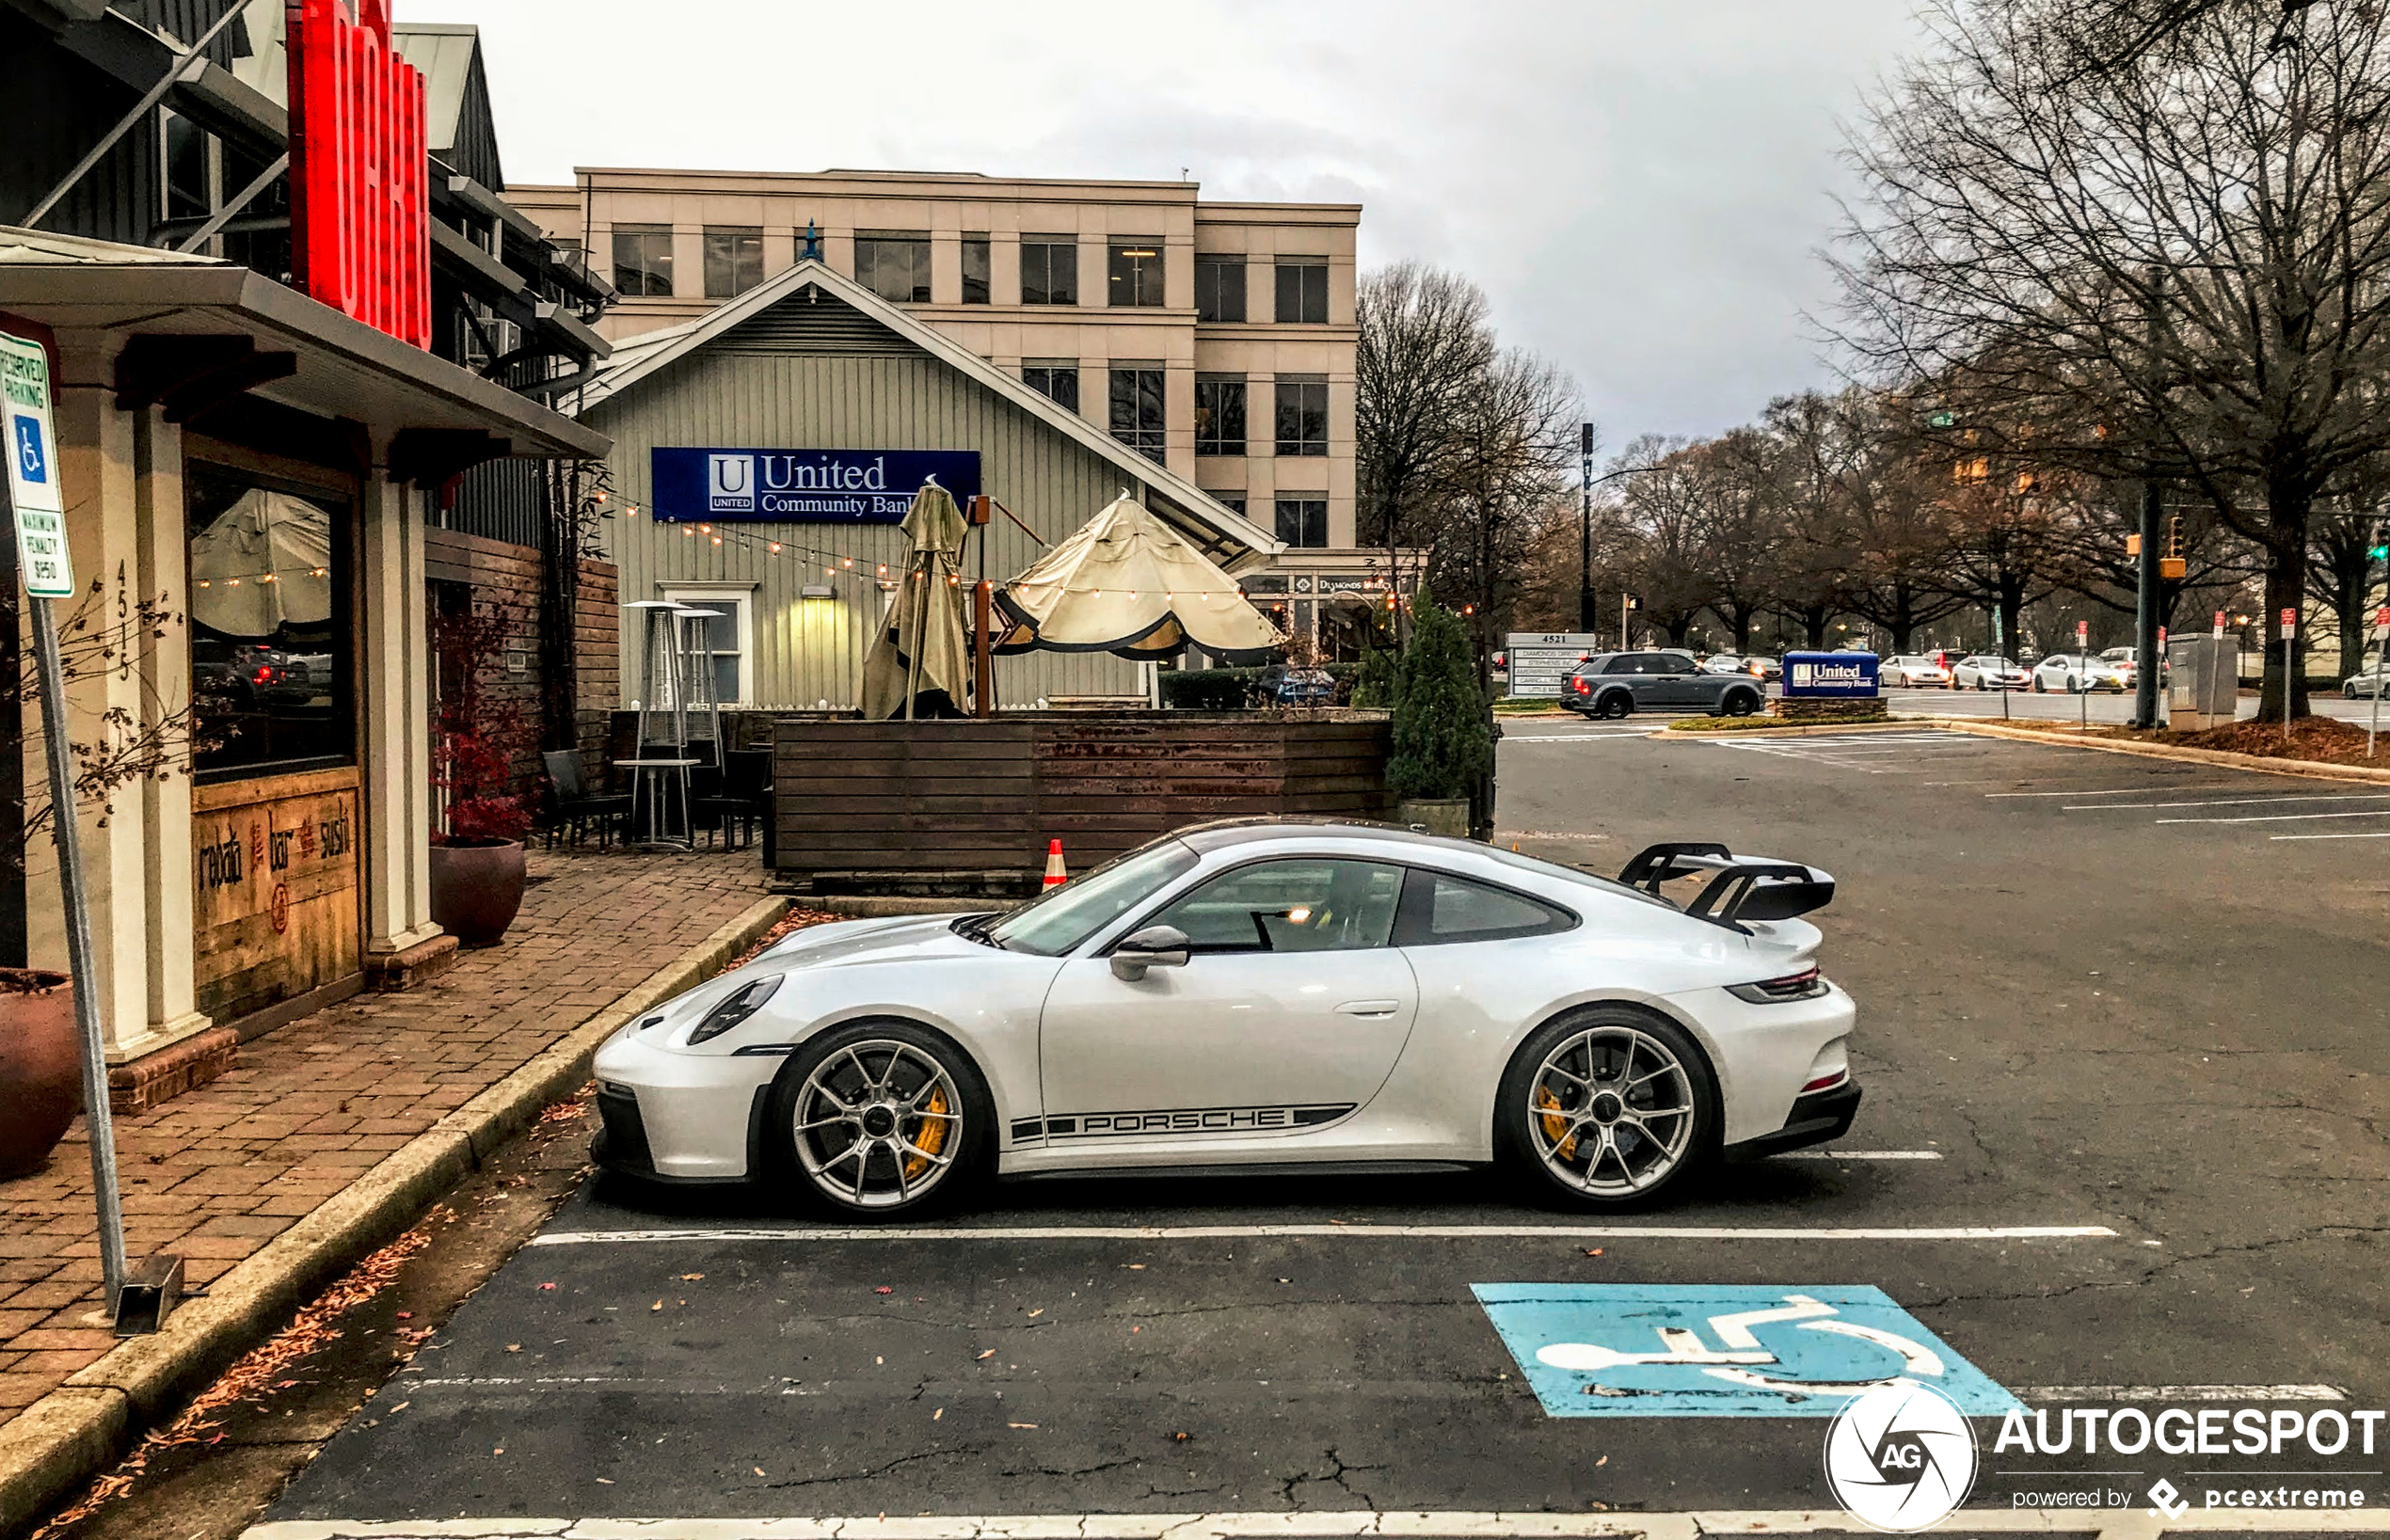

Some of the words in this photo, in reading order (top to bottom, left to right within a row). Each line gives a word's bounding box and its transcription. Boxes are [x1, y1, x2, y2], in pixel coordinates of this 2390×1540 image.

[5, 377, 43, 409] PARKING
[761, 454, 887, 490] United
[713, 499, 751, 508] UNITED
[761, 495, 868, 516] Community
[26, 535, 57, 555] PENALTY
[1542, 635, 1567, 643] 4521
[1812, 663, 1860, 677] United
[1812, 679, 1853, 689] Community
[1084, 1110, 1285, 1133] PORSCHE
